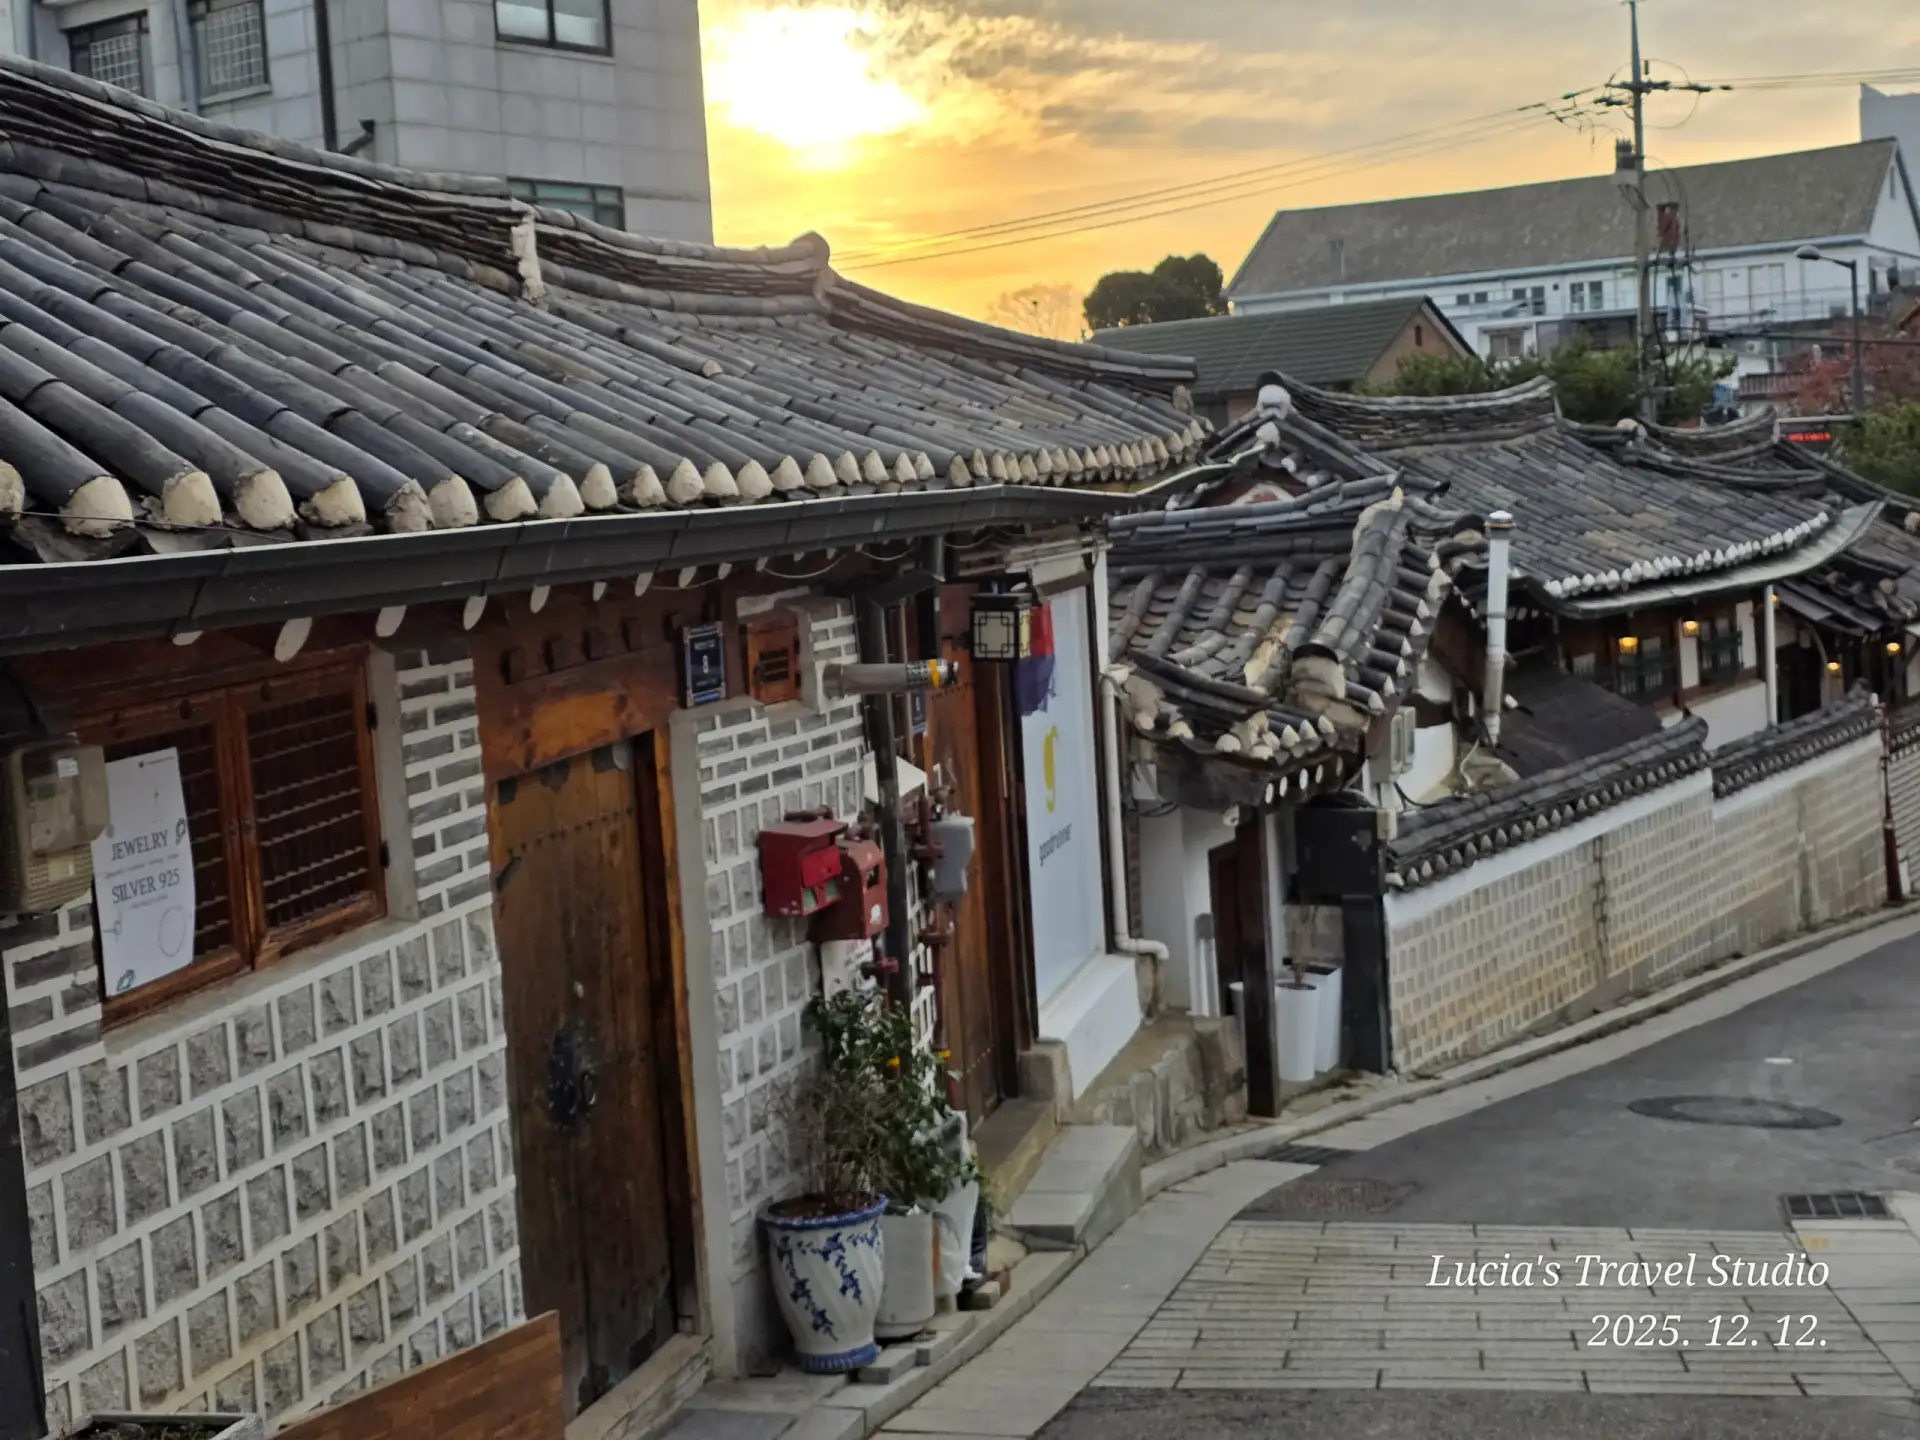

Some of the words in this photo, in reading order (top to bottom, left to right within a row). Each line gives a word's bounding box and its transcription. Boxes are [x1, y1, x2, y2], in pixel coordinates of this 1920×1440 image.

[110, 830, 168, 861] JEWELRY
[111, 875, 157, 904] SILVER
[158, 867, 180, 890] 925
